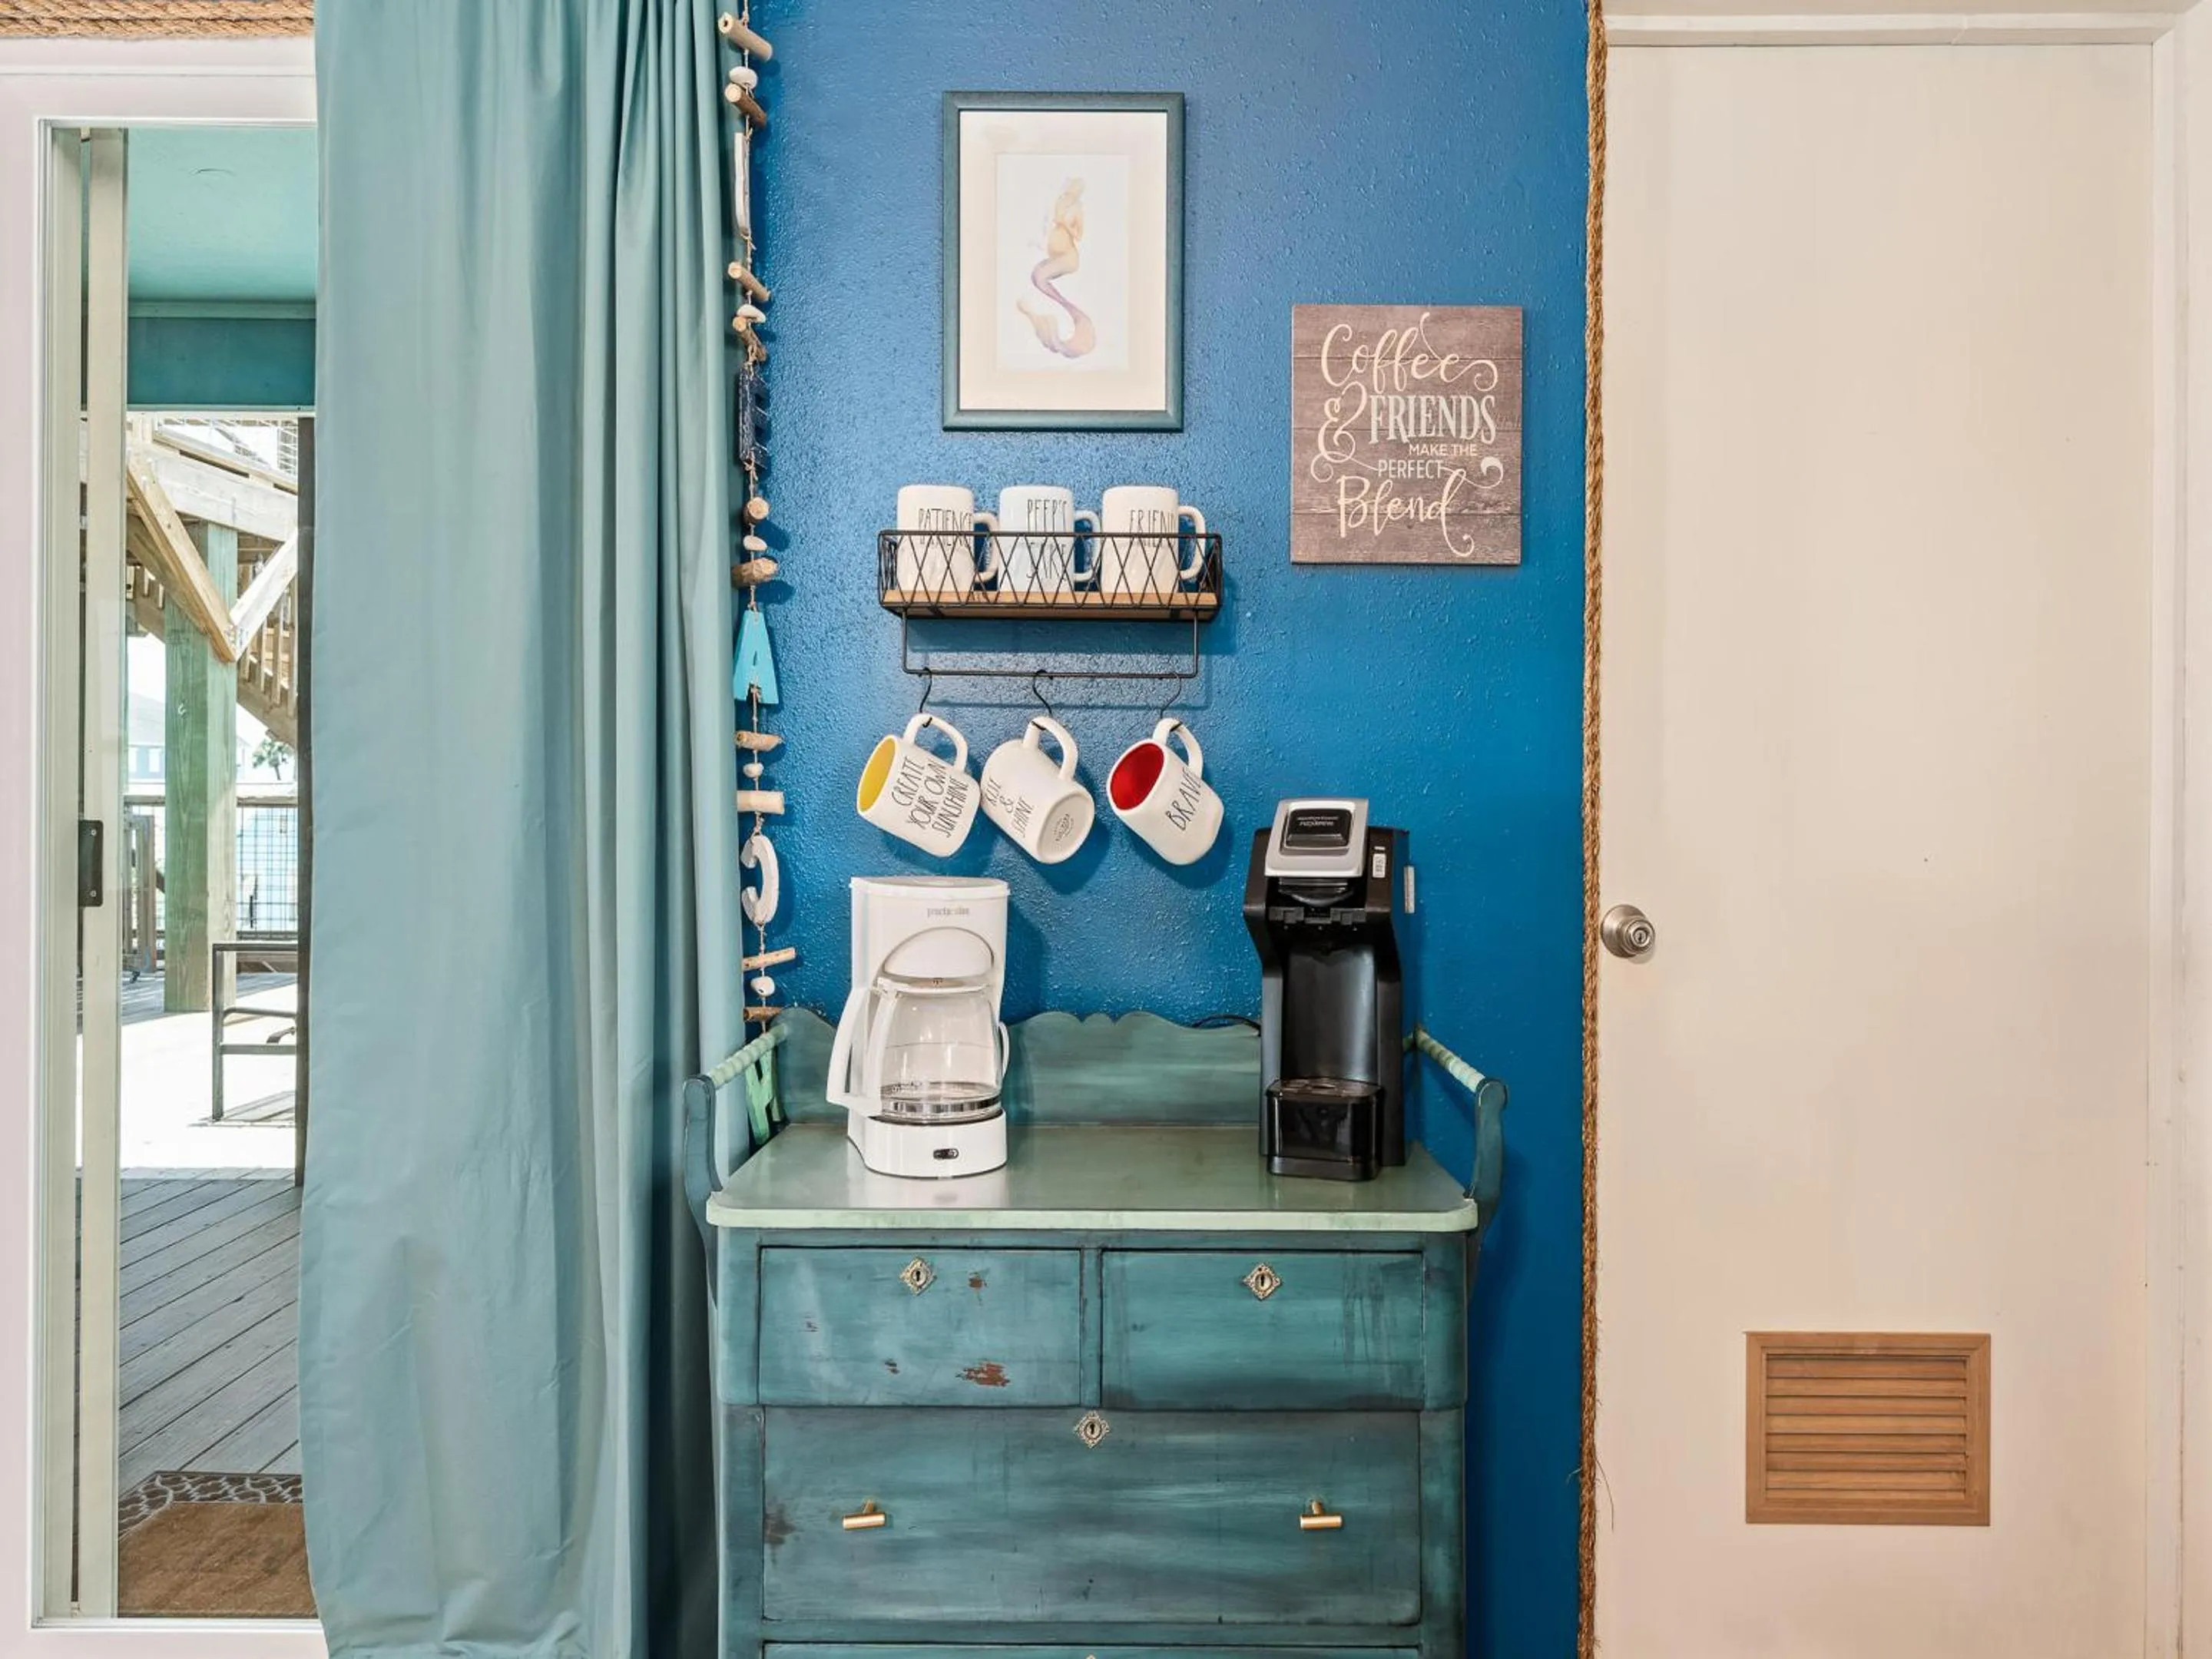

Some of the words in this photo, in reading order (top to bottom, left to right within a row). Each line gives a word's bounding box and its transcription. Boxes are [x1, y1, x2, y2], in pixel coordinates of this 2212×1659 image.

[1321, 312, 1498, 395] Coffee
[1317, 382, 1367, 463] &
[1368, 394, 1496, 445] FRIENDS
[1409, 443, 1448, 456] MAKE
[1452, 443, 1478, 456] THE
[1377, 459, 1444, 479] PERFECT
[1336, 469, 1475, 557] Blend
[891, 755, 925, 806] CREATE
[906, 795, 939, 830] YOUR
[924, 757, 946, 796] OWN
[931, 775, 969, 839] SUNSHINE
[1165, 767, 1201, 831] BRAVE
[1012, 796, 1034, 839] SHINE
